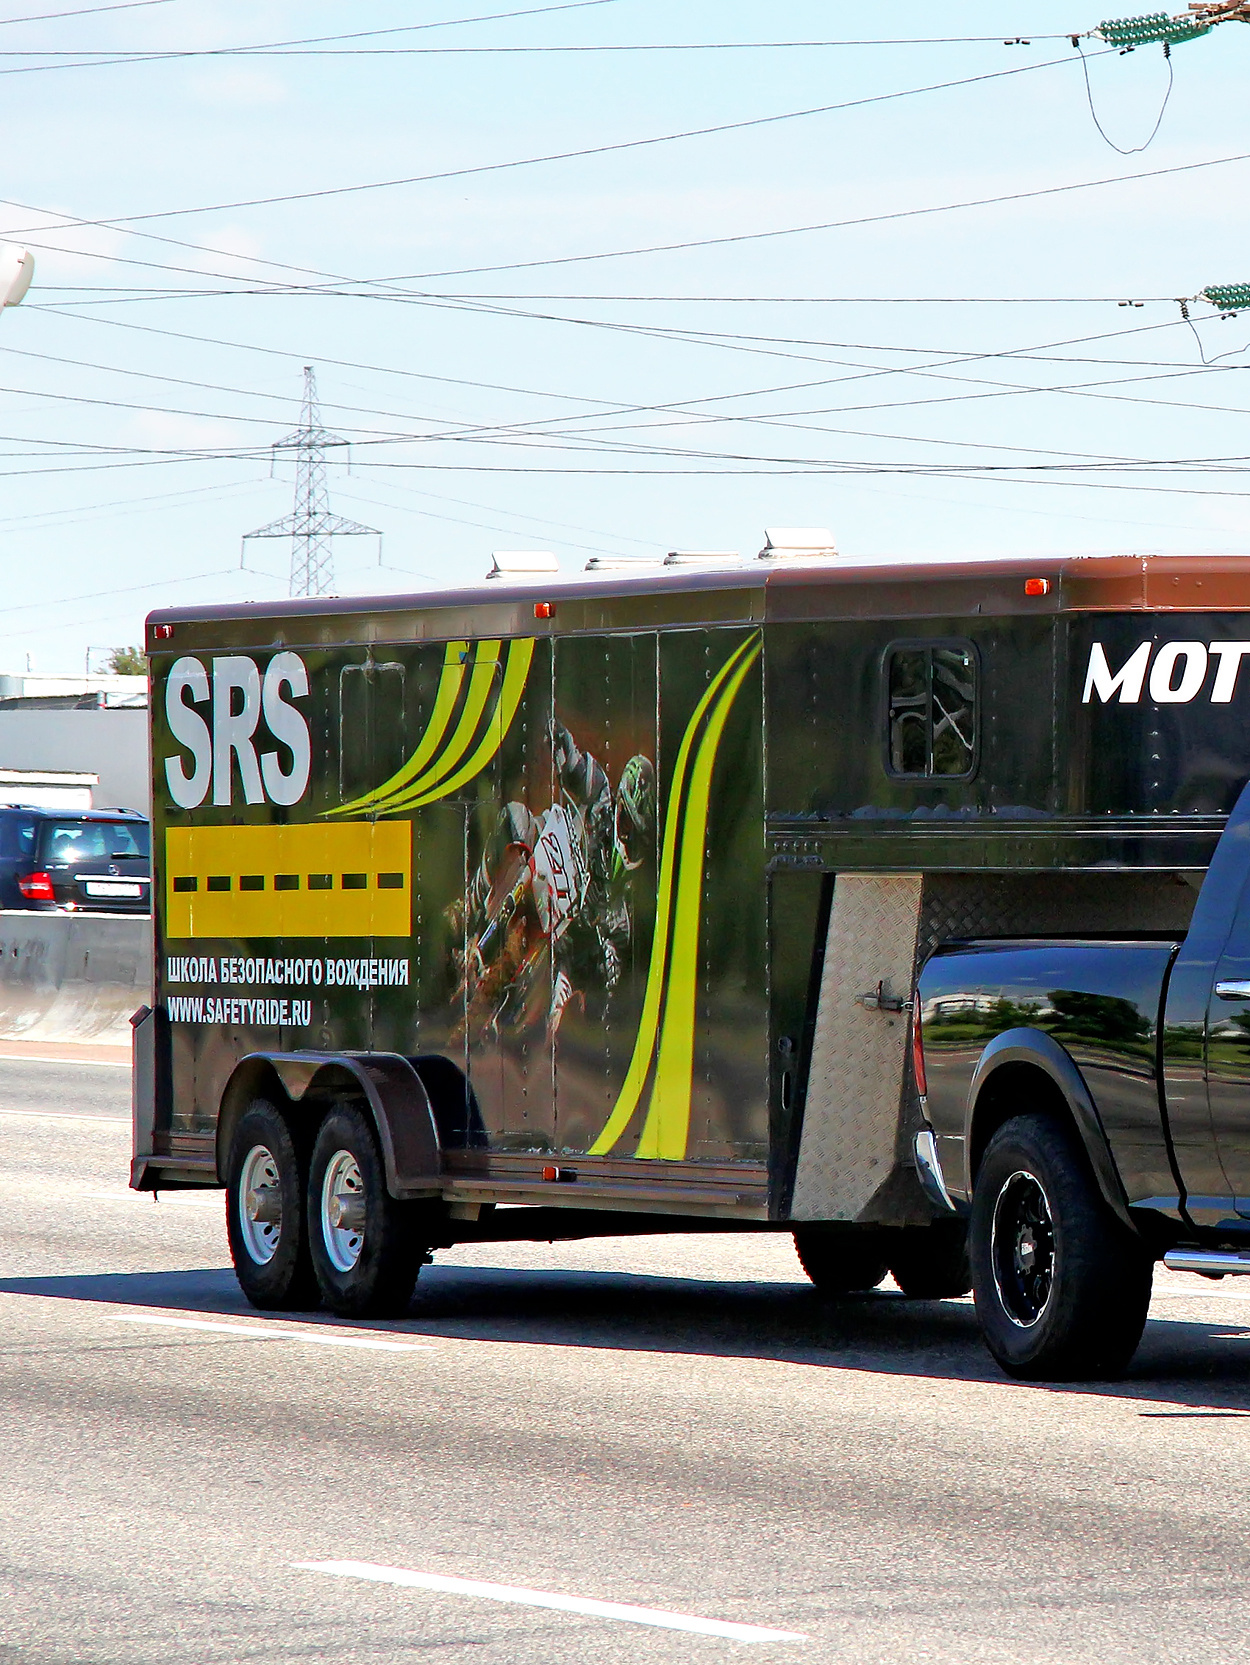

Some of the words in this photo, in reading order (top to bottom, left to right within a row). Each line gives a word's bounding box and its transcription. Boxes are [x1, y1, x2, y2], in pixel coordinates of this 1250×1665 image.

[163, 651, 311, 810] SRS
[167, 956, 217, 983] ШКОЛА
[220, 956, 322, 986] БЕЗОПАСНОГО
[326, 957, 409, 991] ВОЖДЕНИЯ
[167, 996, 312, 1027] WWW.SAFETYRIDE.RU
